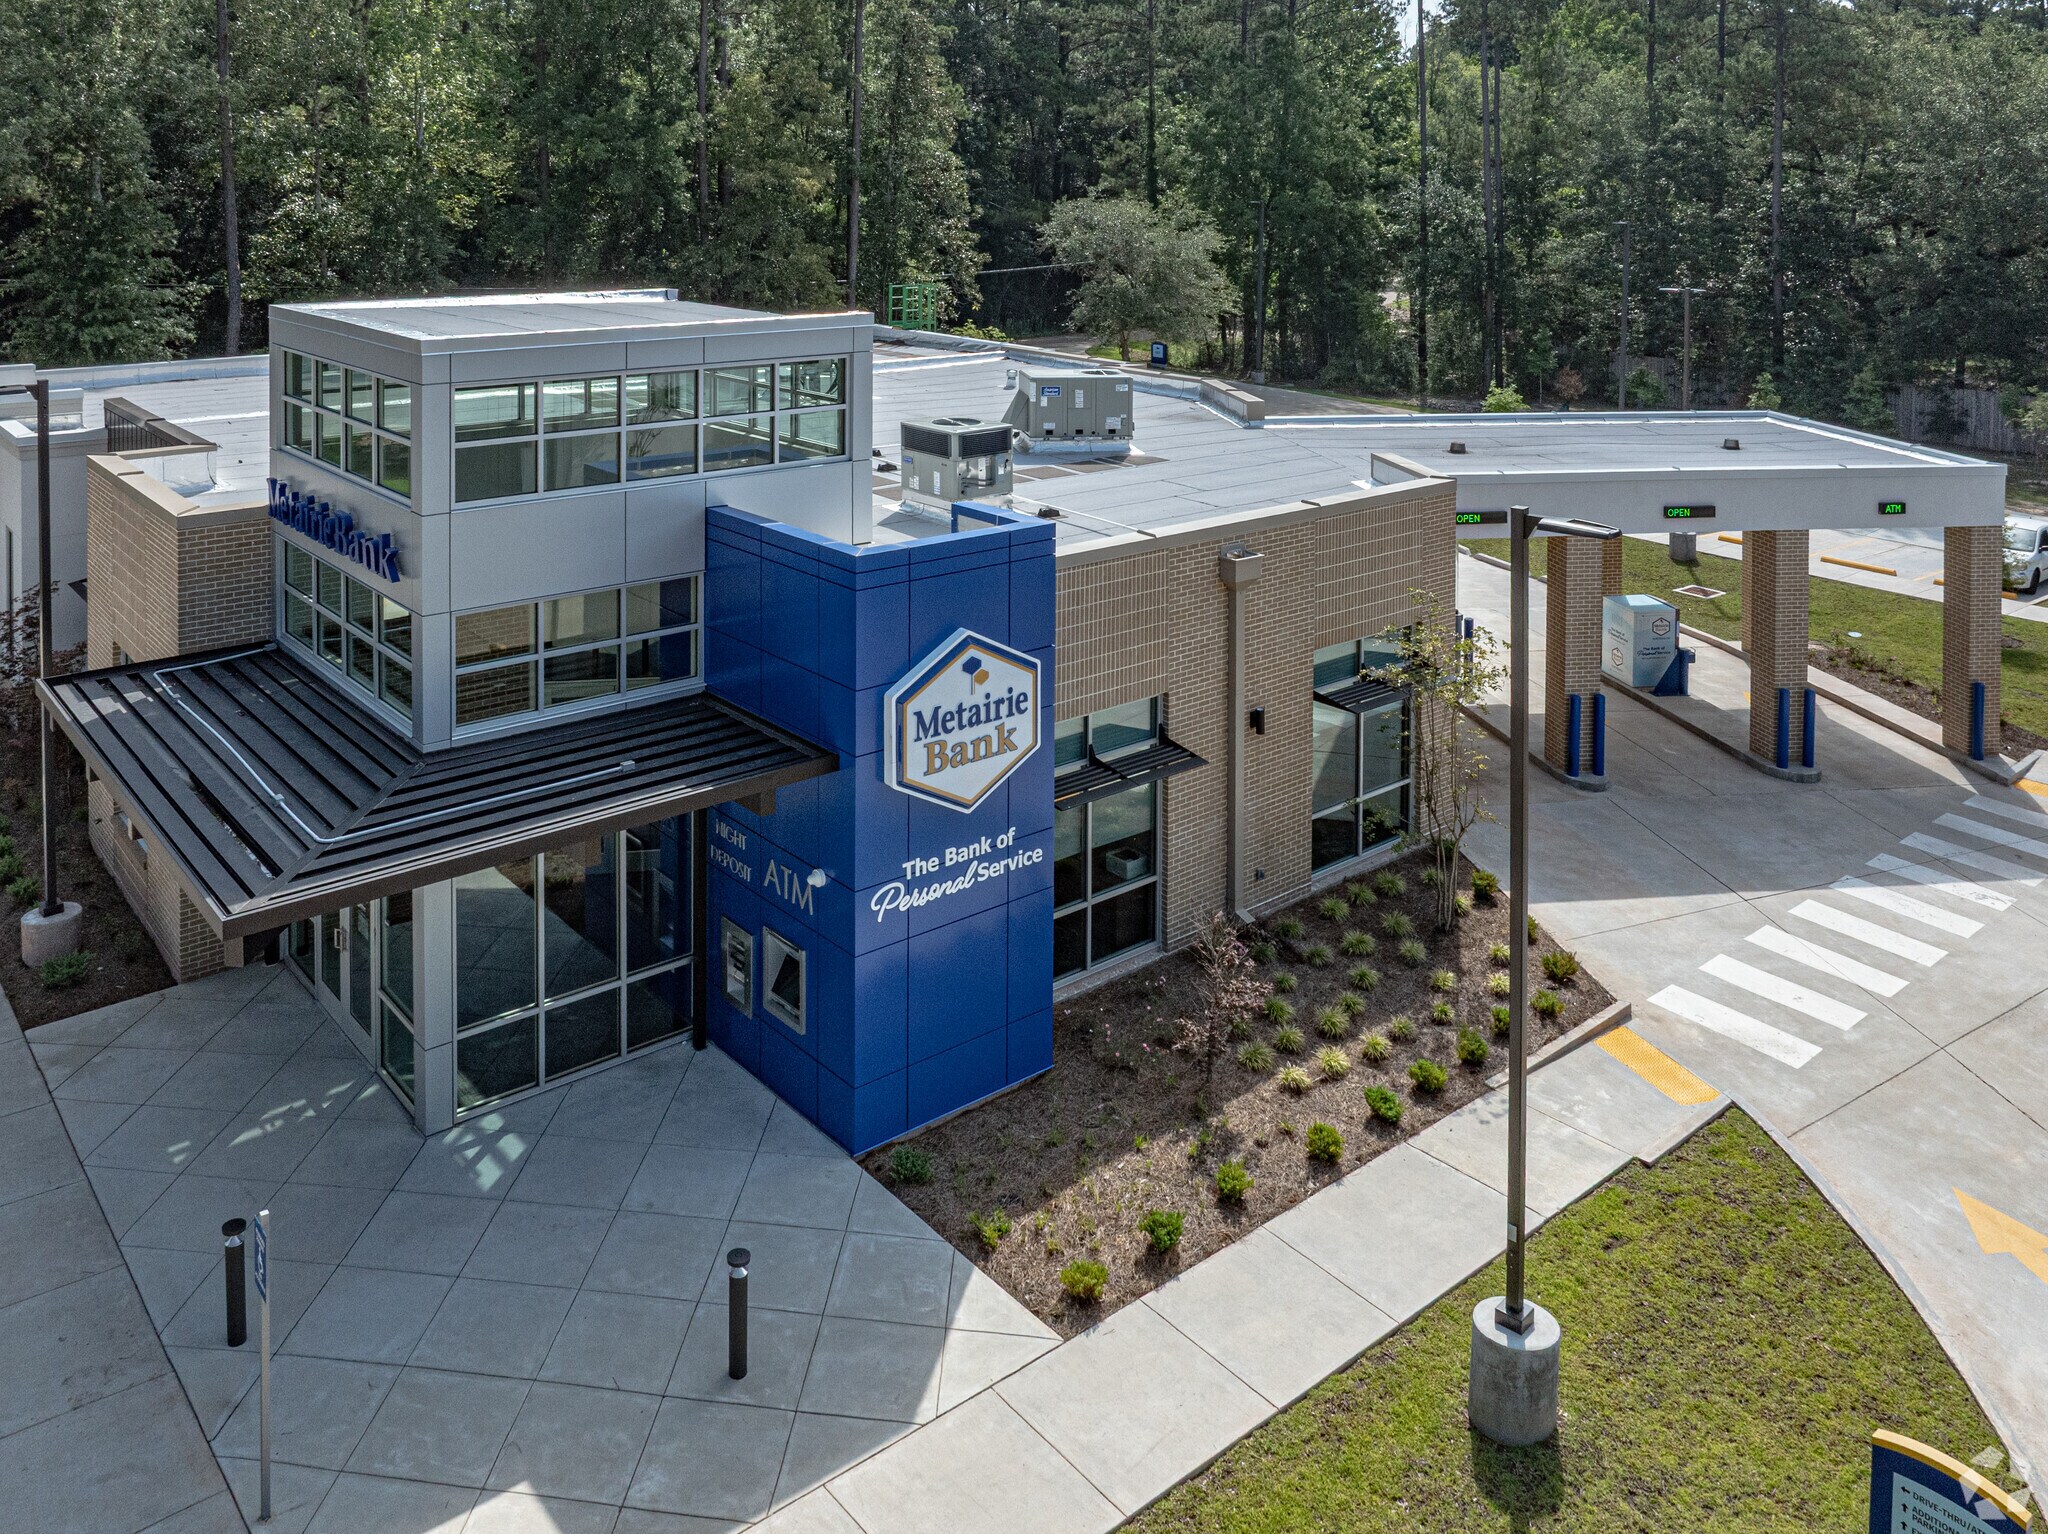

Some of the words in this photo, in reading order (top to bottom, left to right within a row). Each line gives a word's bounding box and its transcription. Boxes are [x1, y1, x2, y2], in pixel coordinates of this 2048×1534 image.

[1456, 513, 1481, 523] OPEN
[1667, 508, 1691, 517] OPEN
[1885, 504, 1902, 514] ATM
[334, 509, 401, 584] Bank
[913, 686, 1029, 743] Metairie
[923, 721, 1019, 777] Bank
[716, 819, 747, 850] NIGHT
[710, 845, 751, 882] DEPOSIT
[902, 855, 940, 881] The
[944, 835, 993, 869] Bank
[995, 826, 1017, 850] of
[763, 858, 814, 916] ATM
[868, 860, 978, 923] Personal
[977, 846, 1044, 883] Service
[1912, 1491, 1967, 1528] DRIVE-THRU
[1912, 1513, 1948, 1534] PARKIN
